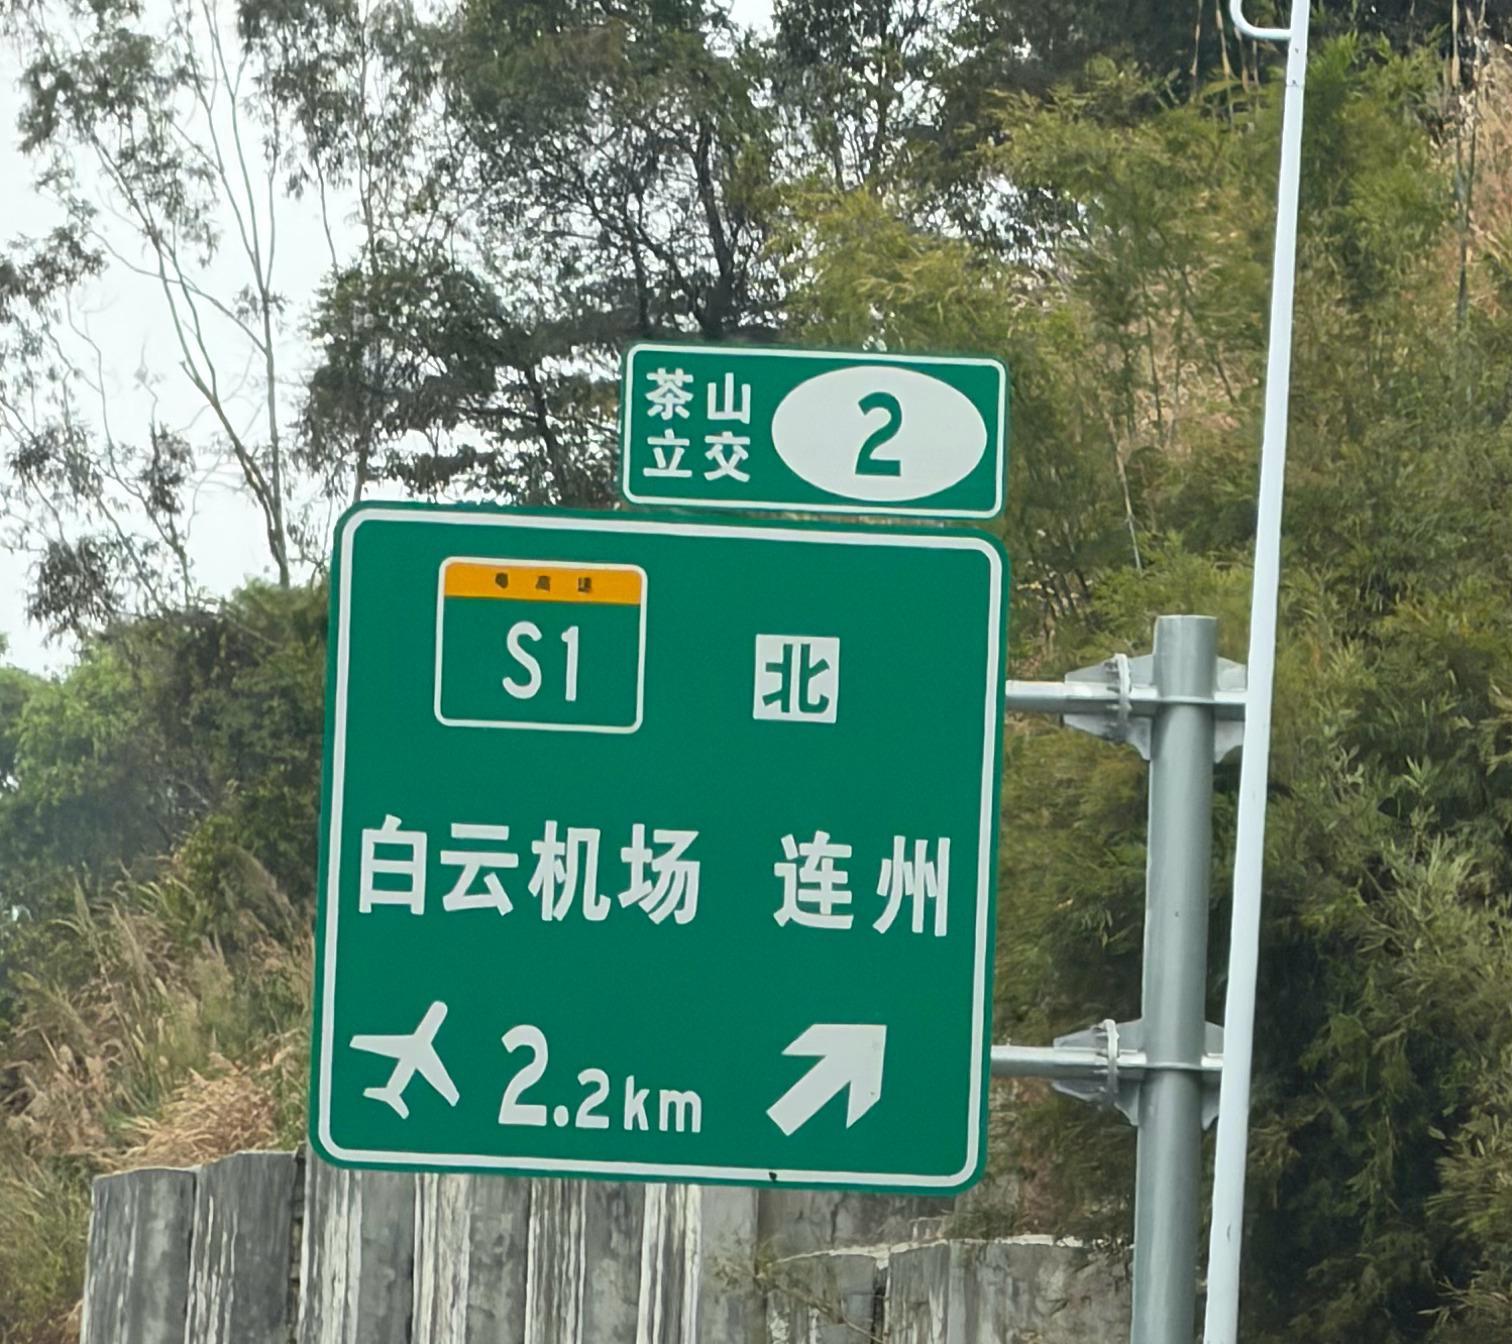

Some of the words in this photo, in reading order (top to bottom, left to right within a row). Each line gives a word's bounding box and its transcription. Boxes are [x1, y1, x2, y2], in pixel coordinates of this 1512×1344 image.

[645, 368, 751, 424] 茶山
[855, 391, 902, 477] 2
[643, 429, 750, 482] 立交
[502, 620, 579, 702] S1
[762, 643, 830, 714] 北
[358, 814, 701, 925] 白云机场
[773, 830, 951, 937] 连州
